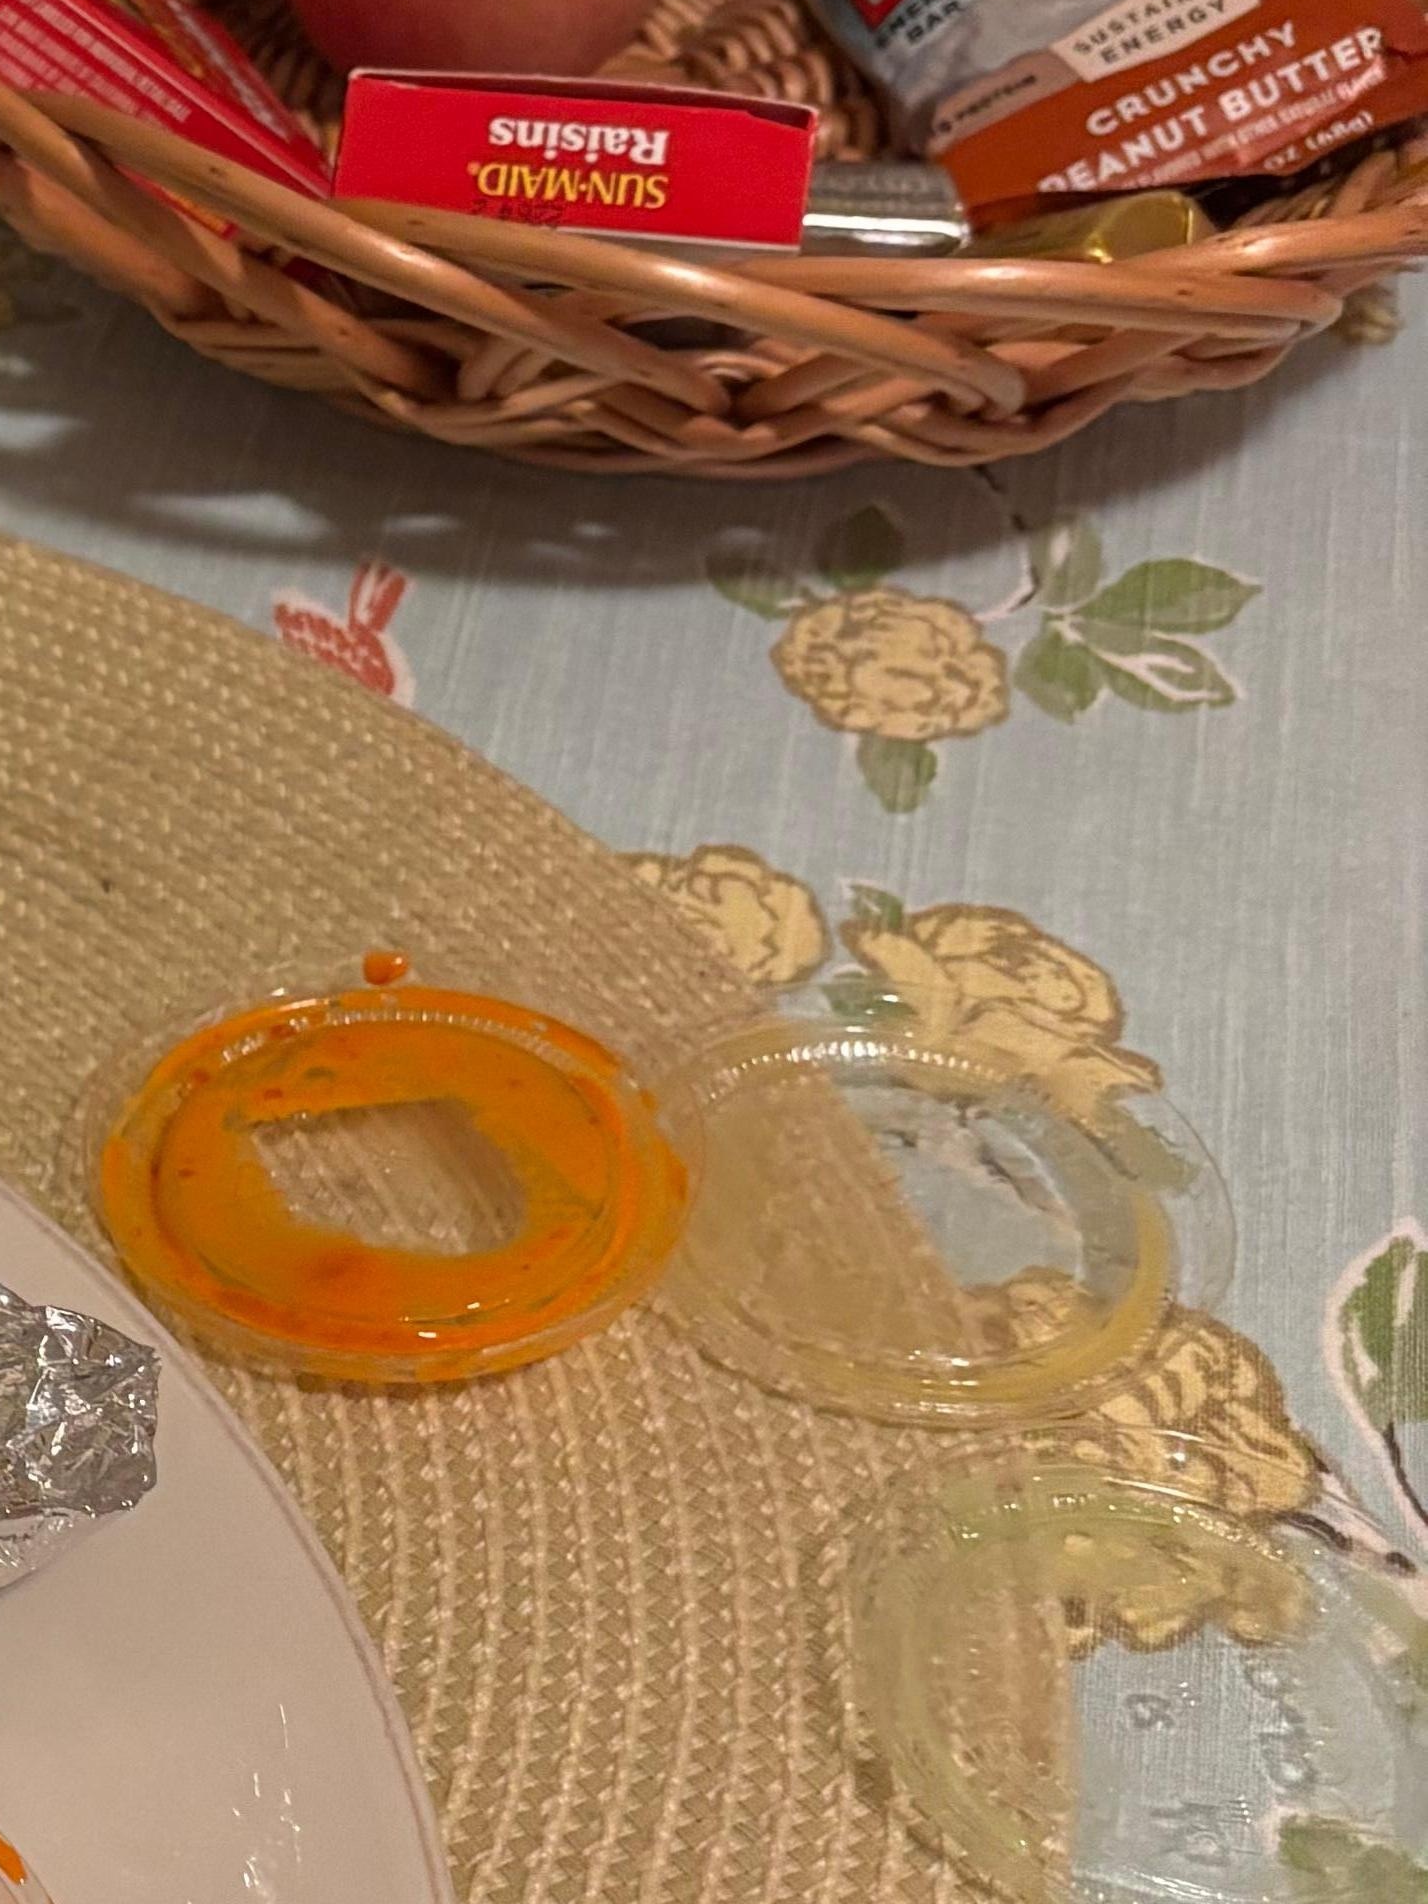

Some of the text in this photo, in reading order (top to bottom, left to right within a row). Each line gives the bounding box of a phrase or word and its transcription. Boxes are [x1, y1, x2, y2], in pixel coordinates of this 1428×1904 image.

[1085, 19, 1296, 136] CRUNCHY
[1217, 26, 1382, 122] BUTTER
[488, 116, 670, 166] Raisins
